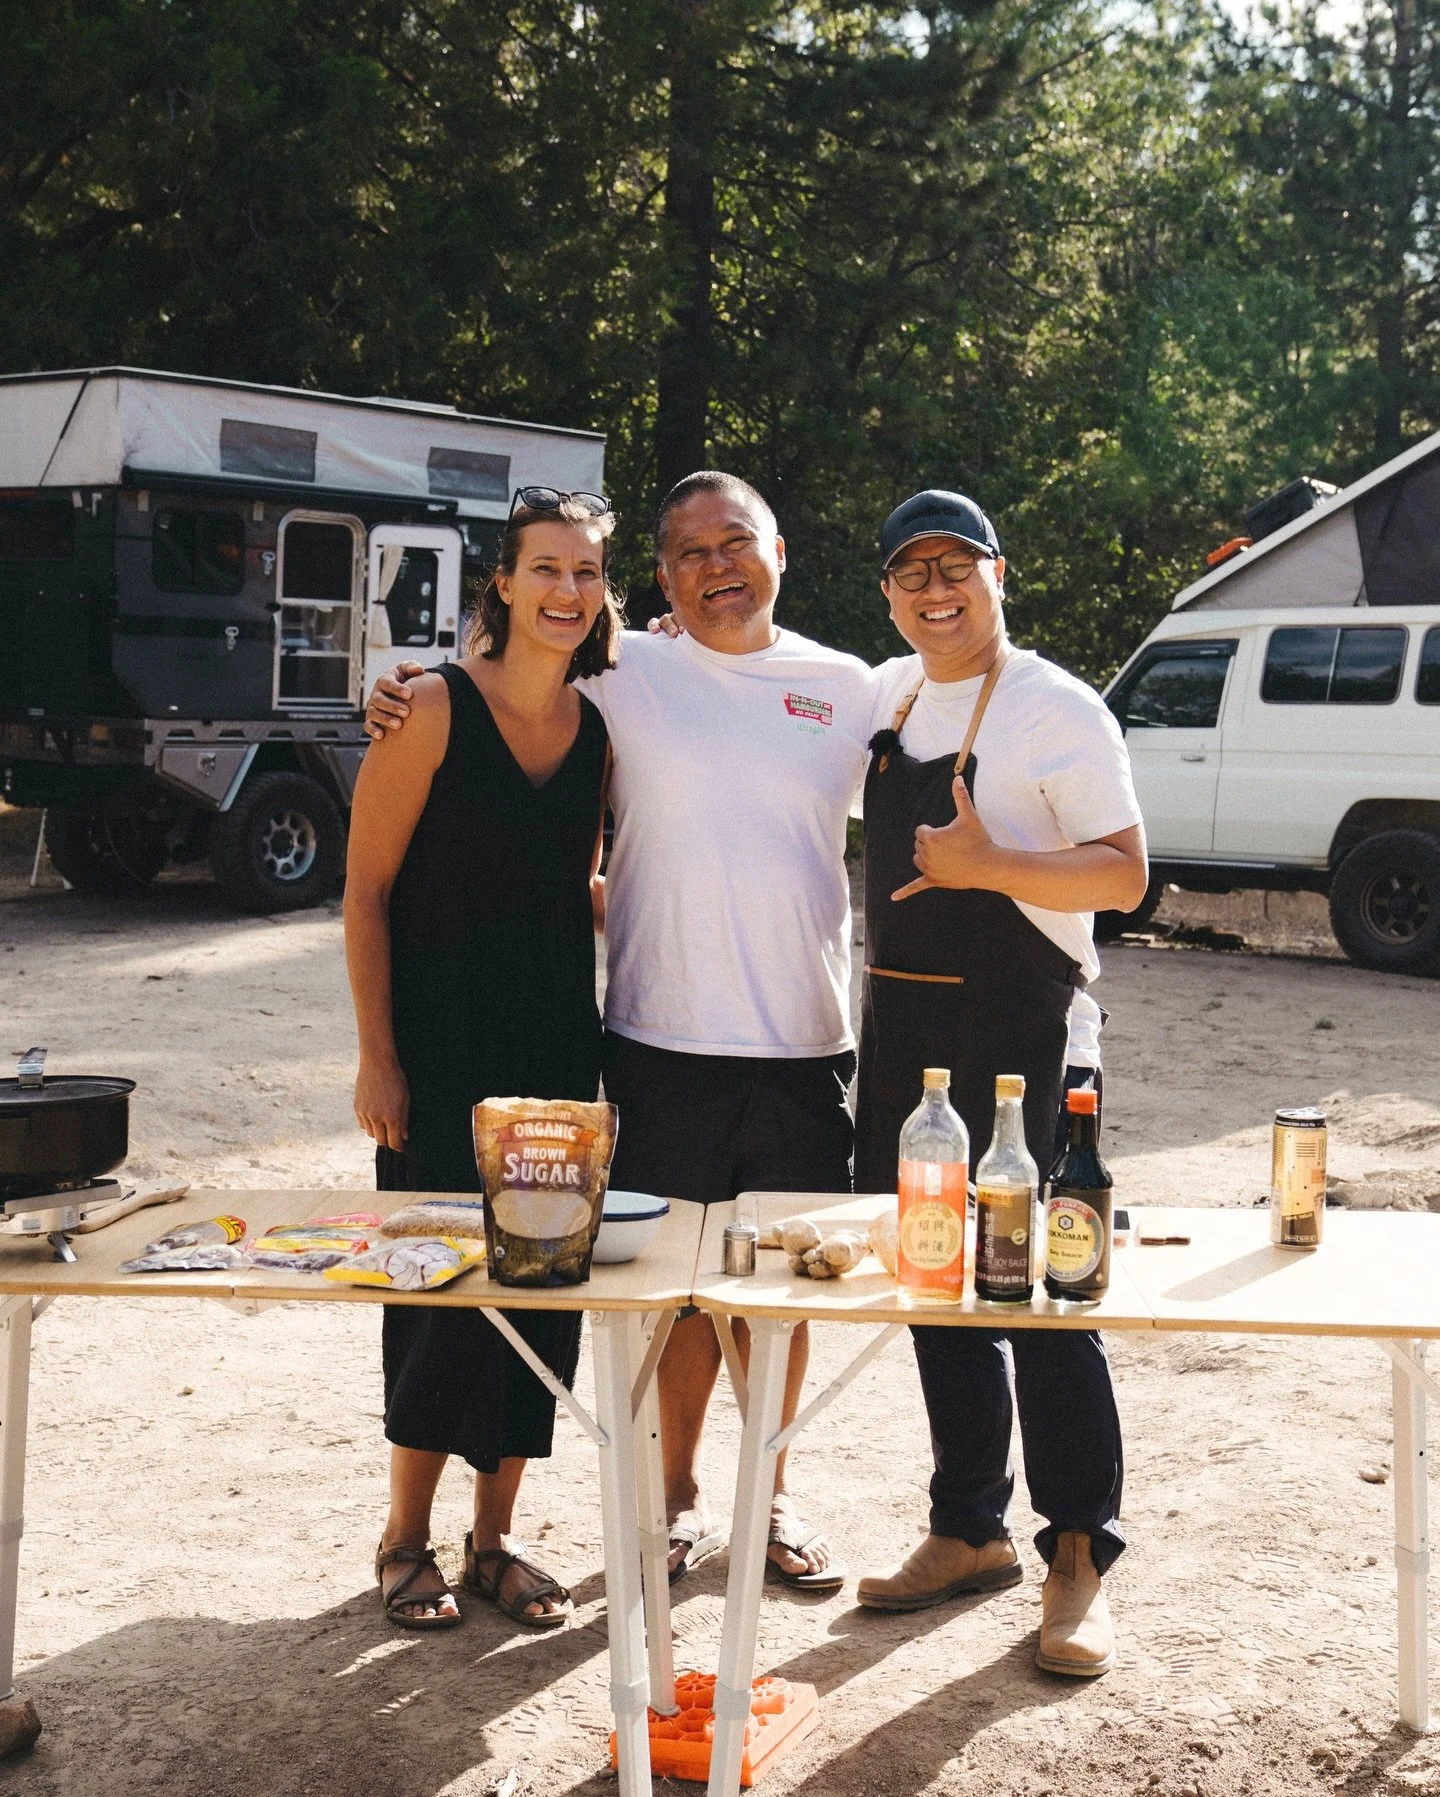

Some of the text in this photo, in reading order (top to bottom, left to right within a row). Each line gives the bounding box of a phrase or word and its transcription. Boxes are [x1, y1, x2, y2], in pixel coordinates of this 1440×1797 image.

[514, 1122, 578, 1141] ORGANIC
[522, 1147, 567, 1161] BROWN
[503, 1152, 581, 1185] SUGAR
[1008, 1258, 1028, 1268] SAUCE
